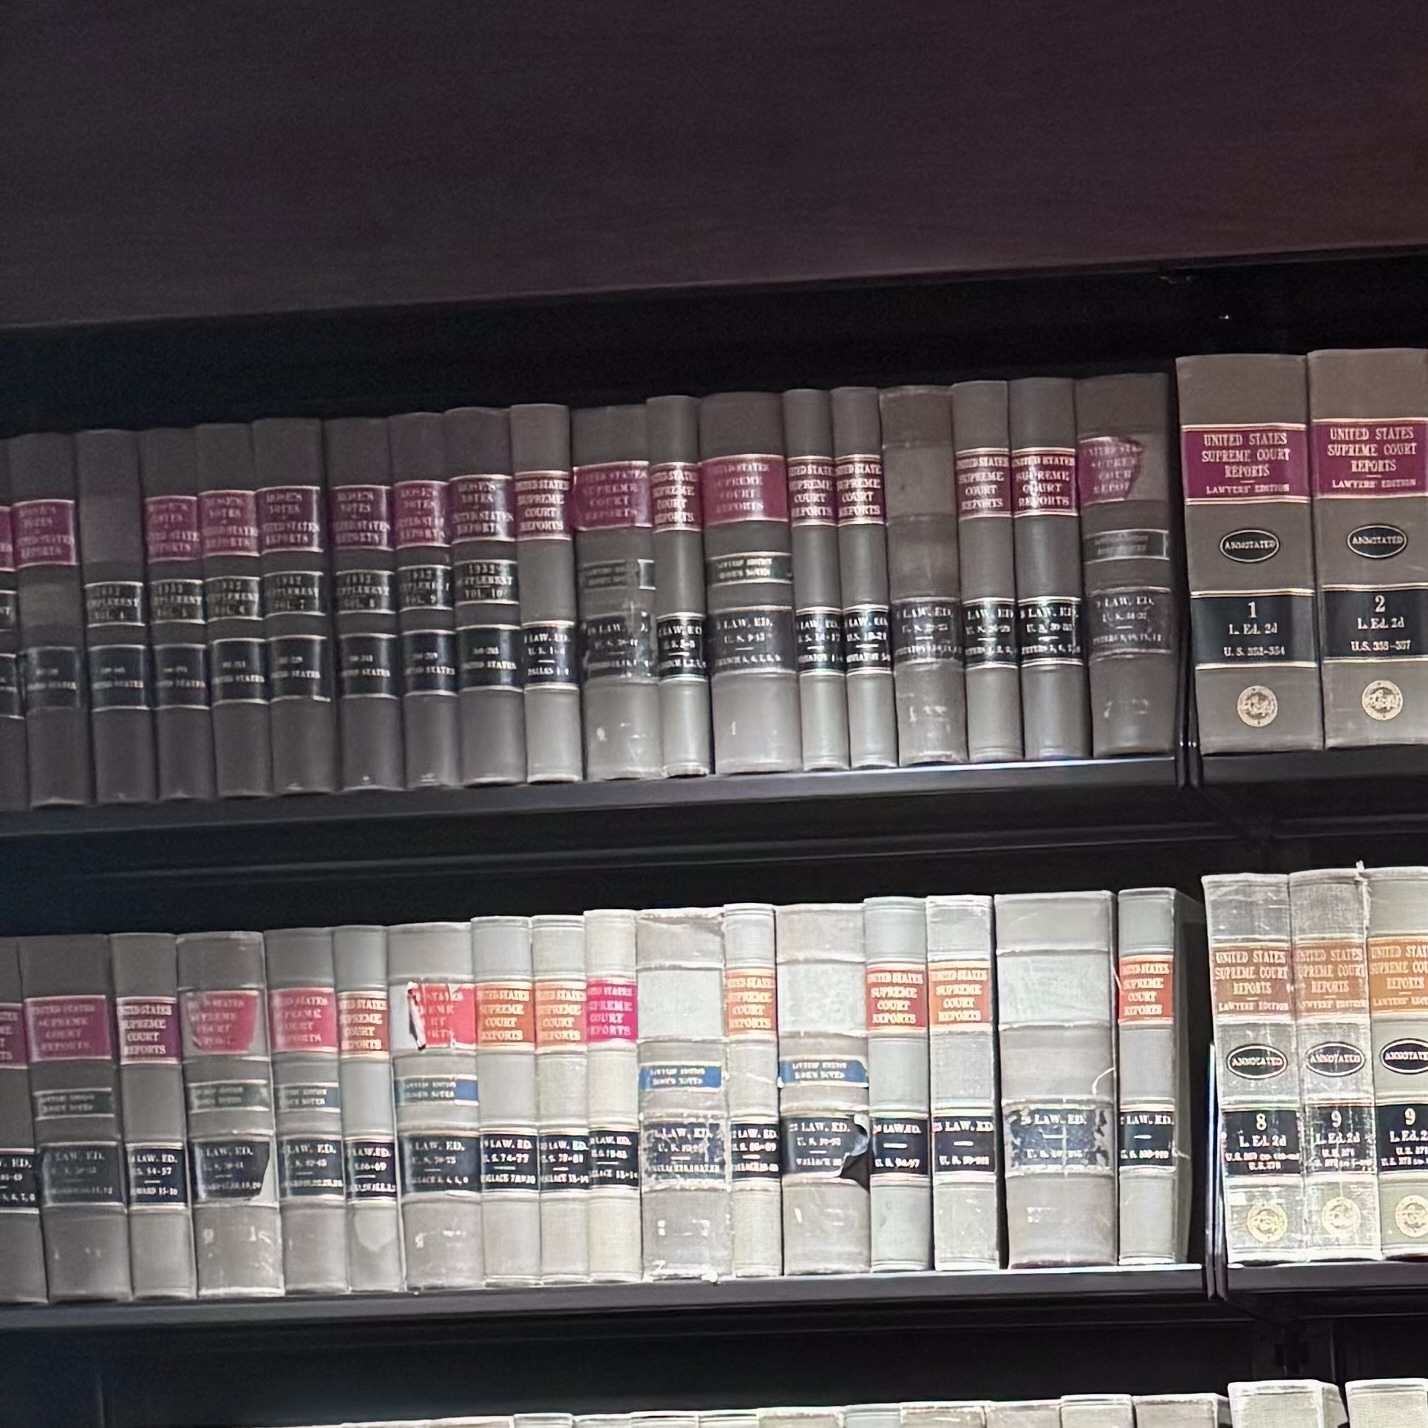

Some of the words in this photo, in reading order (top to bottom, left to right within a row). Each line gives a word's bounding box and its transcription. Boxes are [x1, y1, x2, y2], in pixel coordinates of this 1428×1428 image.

[1204, 432, 1243, 447] UNITED
[1248, 432, 1288, 446] STATES
[1202, 449, 1251, 463] SUPREME
[1256, 448, 1291, 461] COURT
[1225, 464, 1270, 478] REPORTS
[1248, 601, 1258, 618] 1
[1374, 594, 1386, 613] 2
[1330, 1110, 1342, 1128] 9
